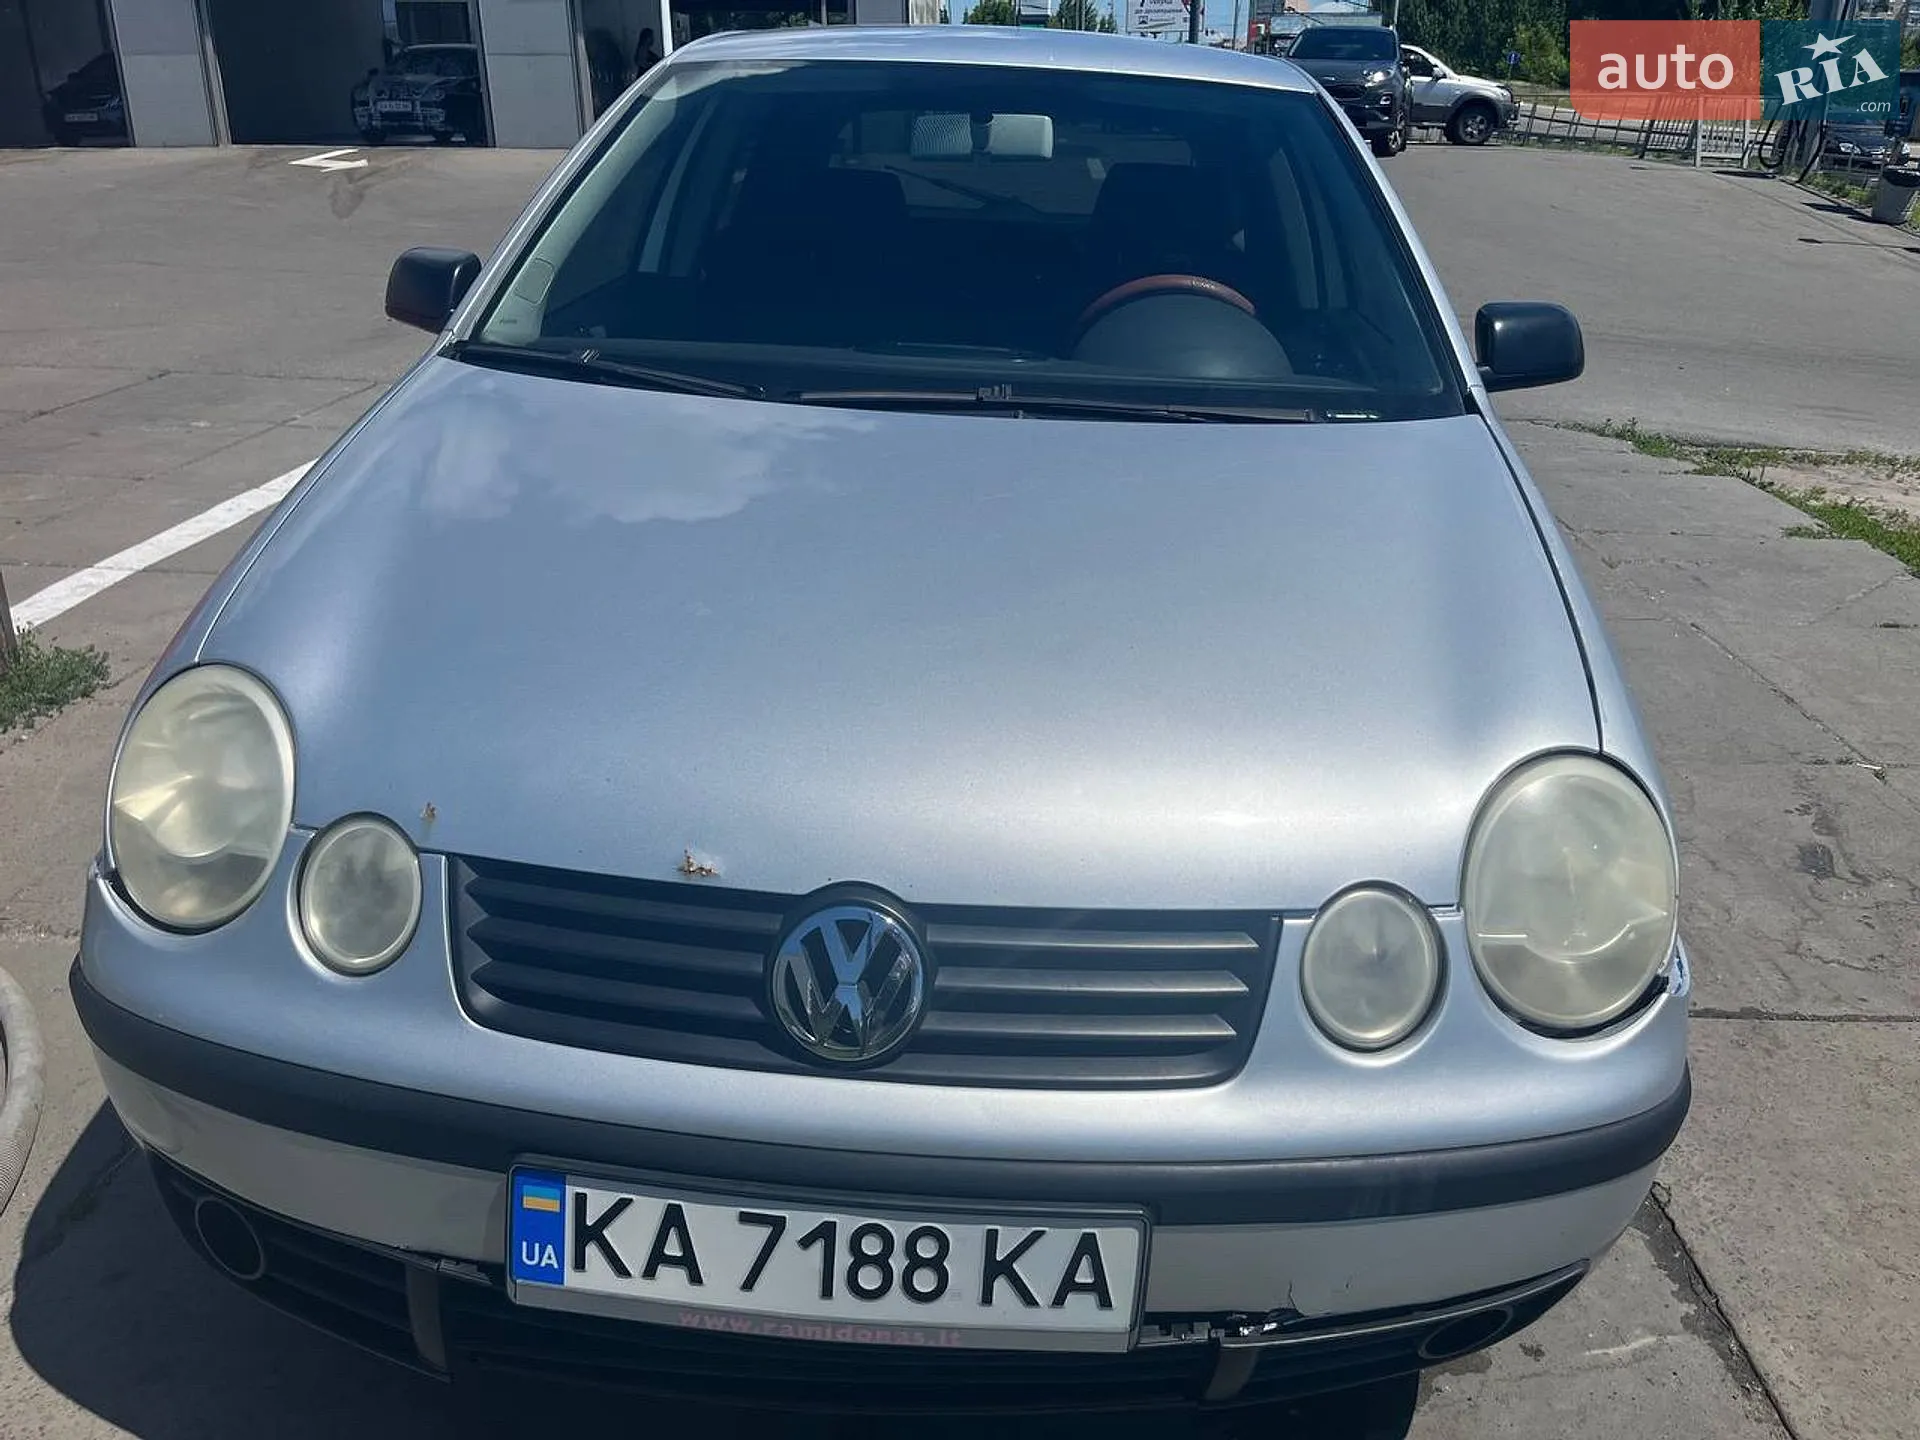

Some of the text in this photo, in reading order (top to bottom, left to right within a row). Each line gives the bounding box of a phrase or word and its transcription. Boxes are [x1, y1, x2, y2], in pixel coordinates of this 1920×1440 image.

[522, 1240, 559, 1269] UA
[572, 1191, 1113, 1309] KA 7188 KA
